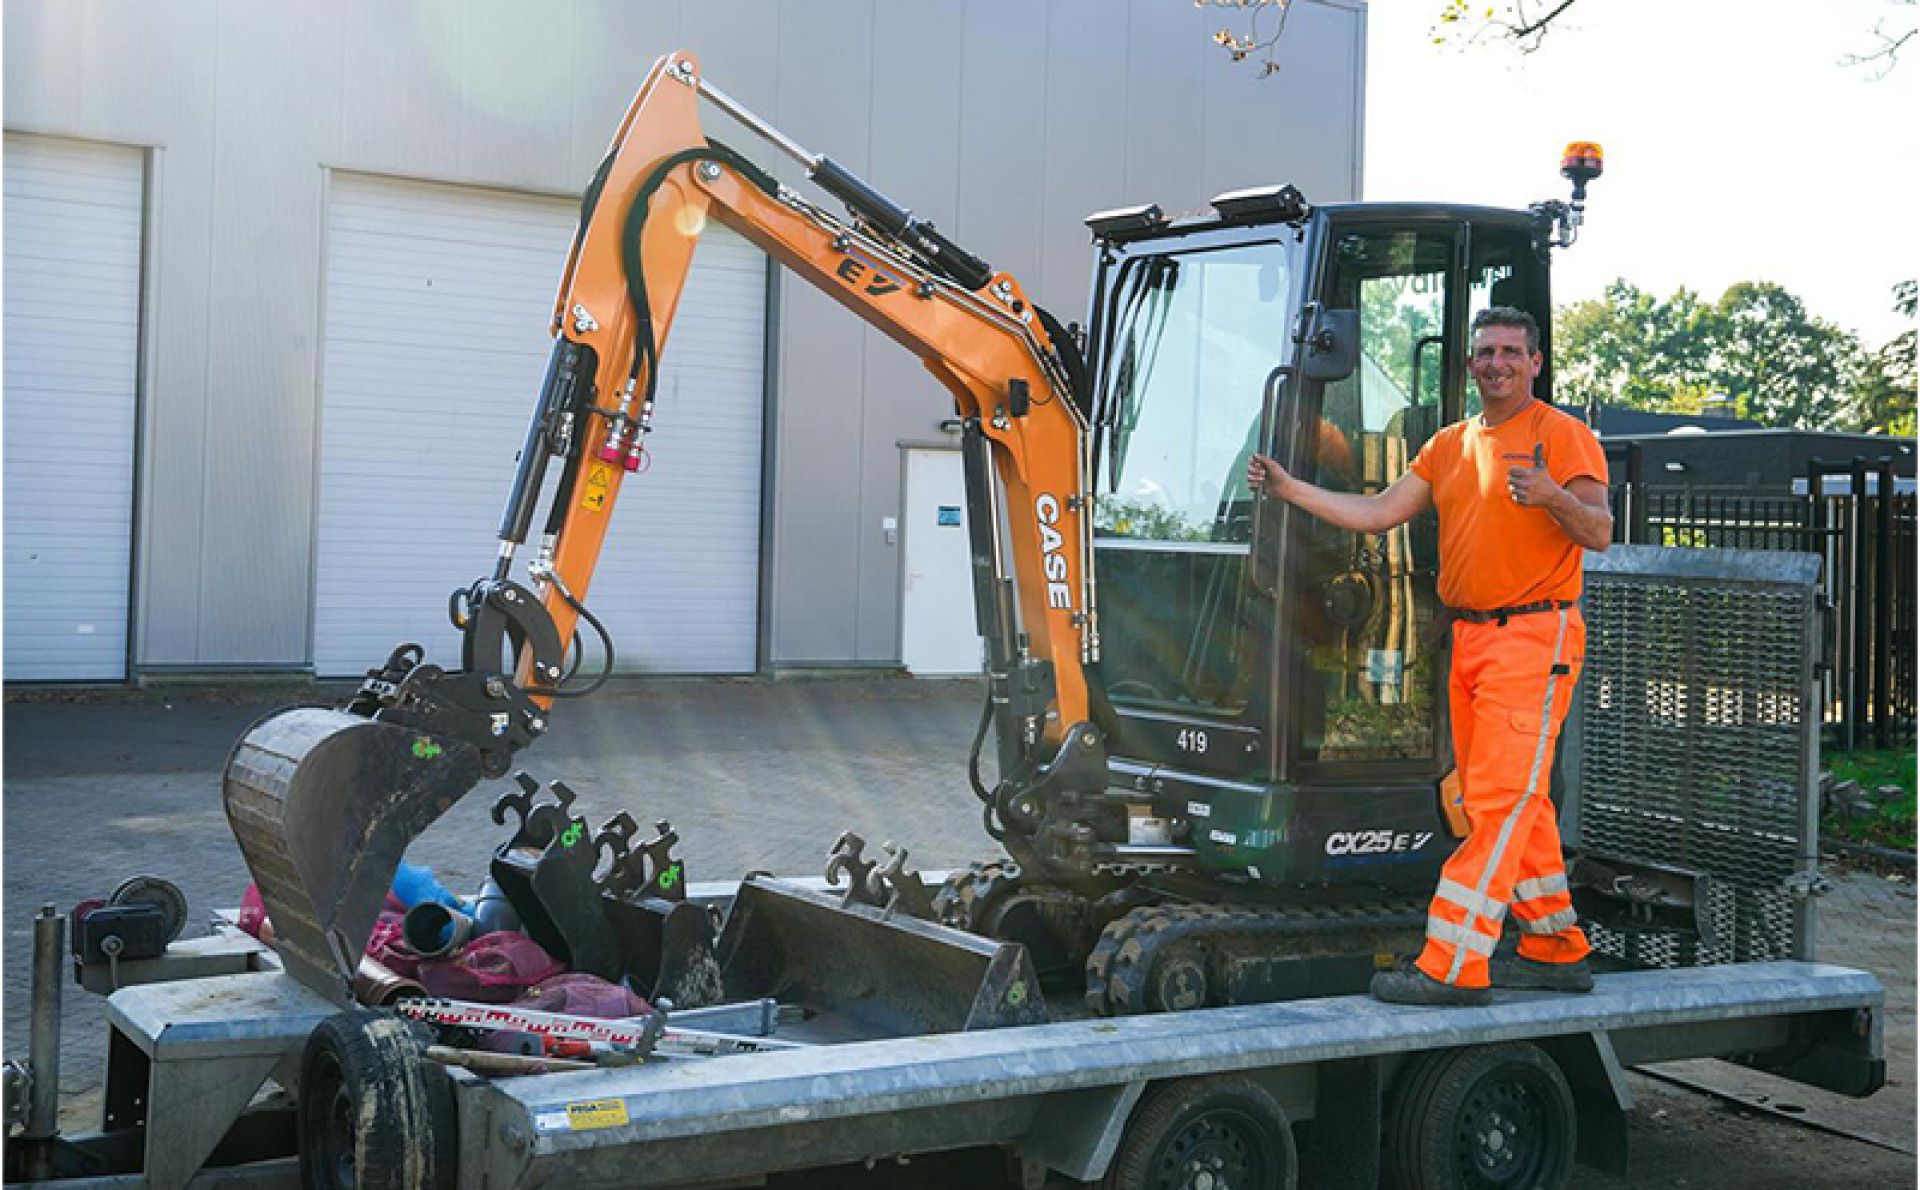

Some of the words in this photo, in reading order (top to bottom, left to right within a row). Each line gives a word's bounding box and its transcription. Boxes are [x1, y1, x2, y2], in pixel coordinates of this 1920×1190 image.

[837, 258, 901, 296] EV
[1035, 492, 1072, 609] CASE
[1176, 729, 1208, 752] 419
